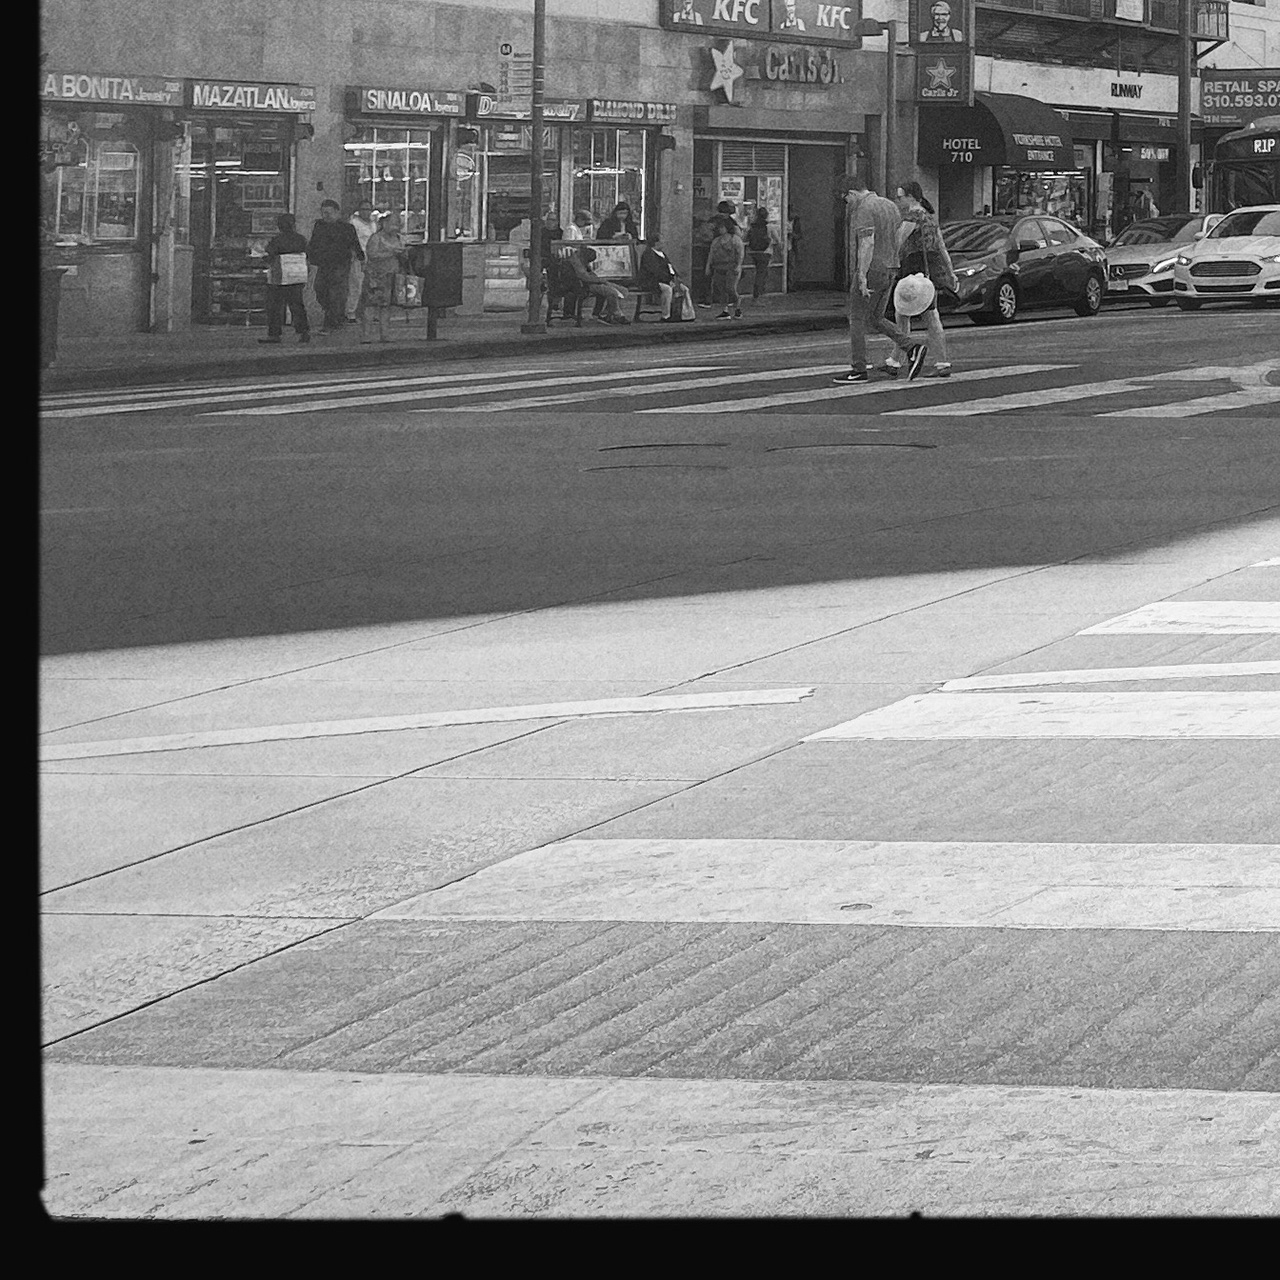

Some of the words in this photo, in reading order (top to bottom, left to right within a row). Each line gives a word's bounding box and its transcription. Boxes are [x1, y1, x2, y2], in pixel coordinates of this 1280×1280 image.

[816, 4, 851, 29] KFC
[62, 75, 134, 100] BONITA
[1203, 80, 1253, 93] RETAIL
[193, 84, 290, 109] MAZATLAN
[367, 89, 431, 112] SINALOA
[943, 138, 981, 151] HOTEL
[1254, 138, 1276, 153] RIP
[951, 152, 973, 163] 710
